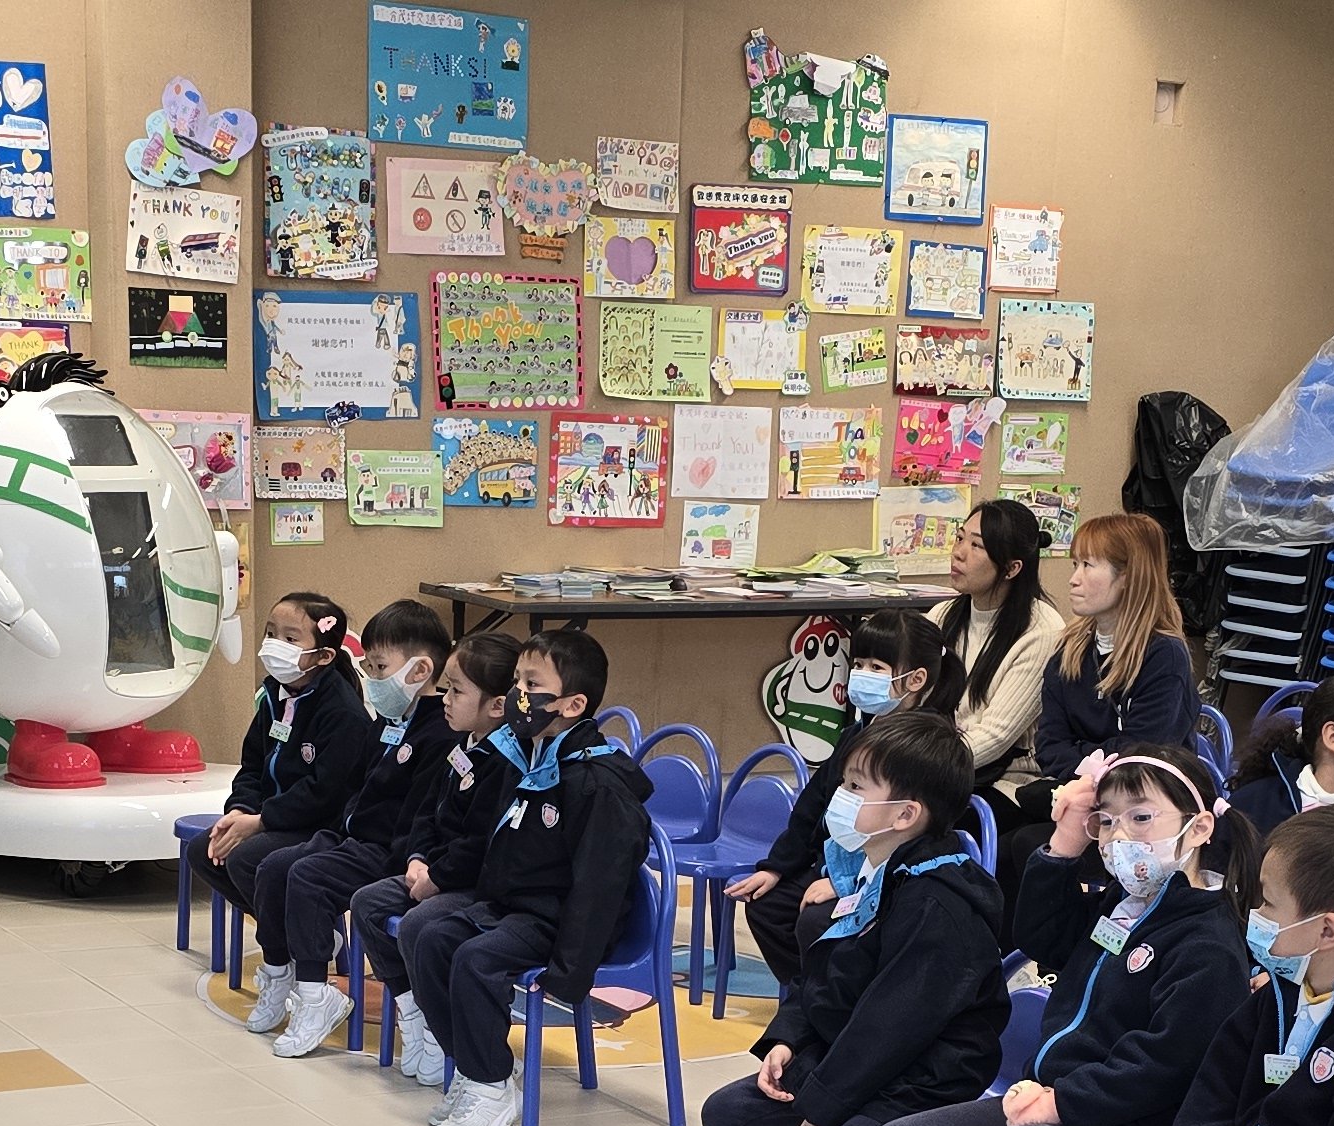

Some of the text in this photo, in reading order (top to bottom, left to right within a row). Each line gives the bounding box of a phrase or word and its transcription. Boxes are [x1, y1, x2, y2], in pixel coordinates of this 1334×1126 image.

[383, 46, 487, 79] THANKS!
[142, 199, 230, 224] THANK YOU
[10, 246, 41, 258] THANK
[727, 231, 776, 256] Thank you
[447, 300, 523, 343] Thank
[8, 340, 41, 351] THANK
[494, 321, 544, 348] You!
[833, 418, 884, 443] Thank
[841, 441, 867, 464] You
[283, 513, 314, 523] THANK
[289, 526, 308, 535] YOU
